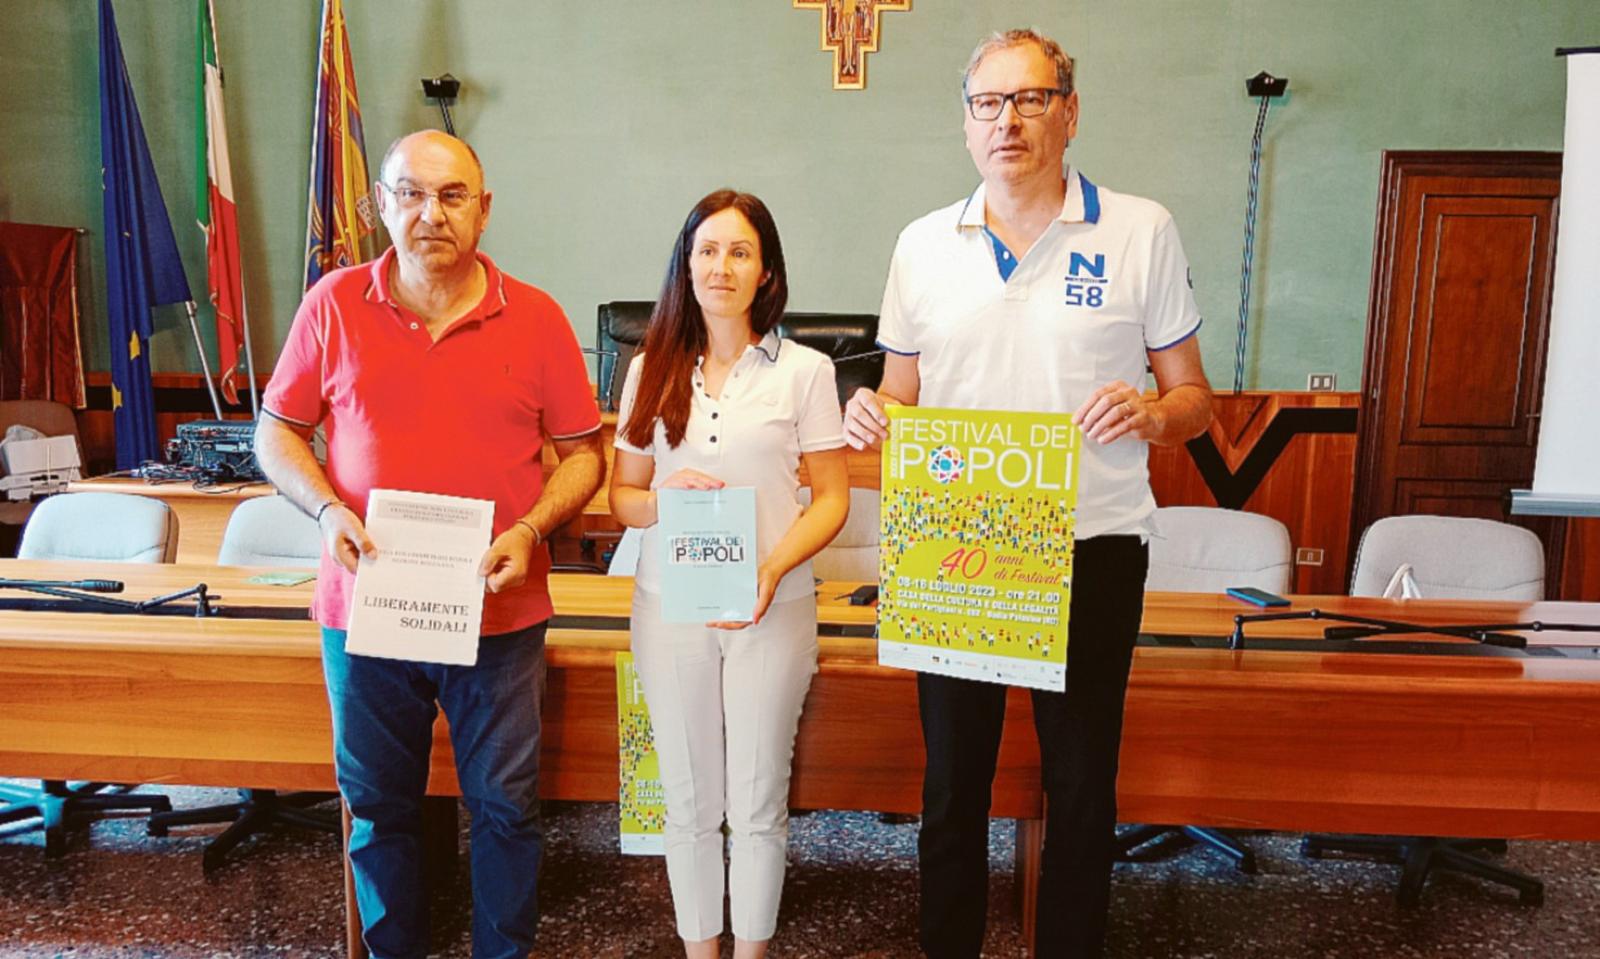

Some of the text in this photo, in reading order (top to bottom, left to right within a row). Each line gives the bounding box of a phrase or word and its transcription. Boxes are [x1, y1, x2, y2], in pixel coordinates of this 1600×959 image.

[1069, 252, 1105, 278] N
[1065, 284, 1103, 307] 58
[900, 418, 1075, 448] FESTIVAL DEI
[900, 443, 1073, 490] POPOLI
[675, 537, 721, 547] FESTIVAL
[676, 546, 744, 562] POPOLI
[941, 547, 1024, 579] 40 anni
[994, 567, 1062, 585] di Festival
[929, 580, 966, 593] LUGLIO
[364, 596, 469, 616] LIBERAMENTE
[400, 617, 467, 633] SOLIDALI
